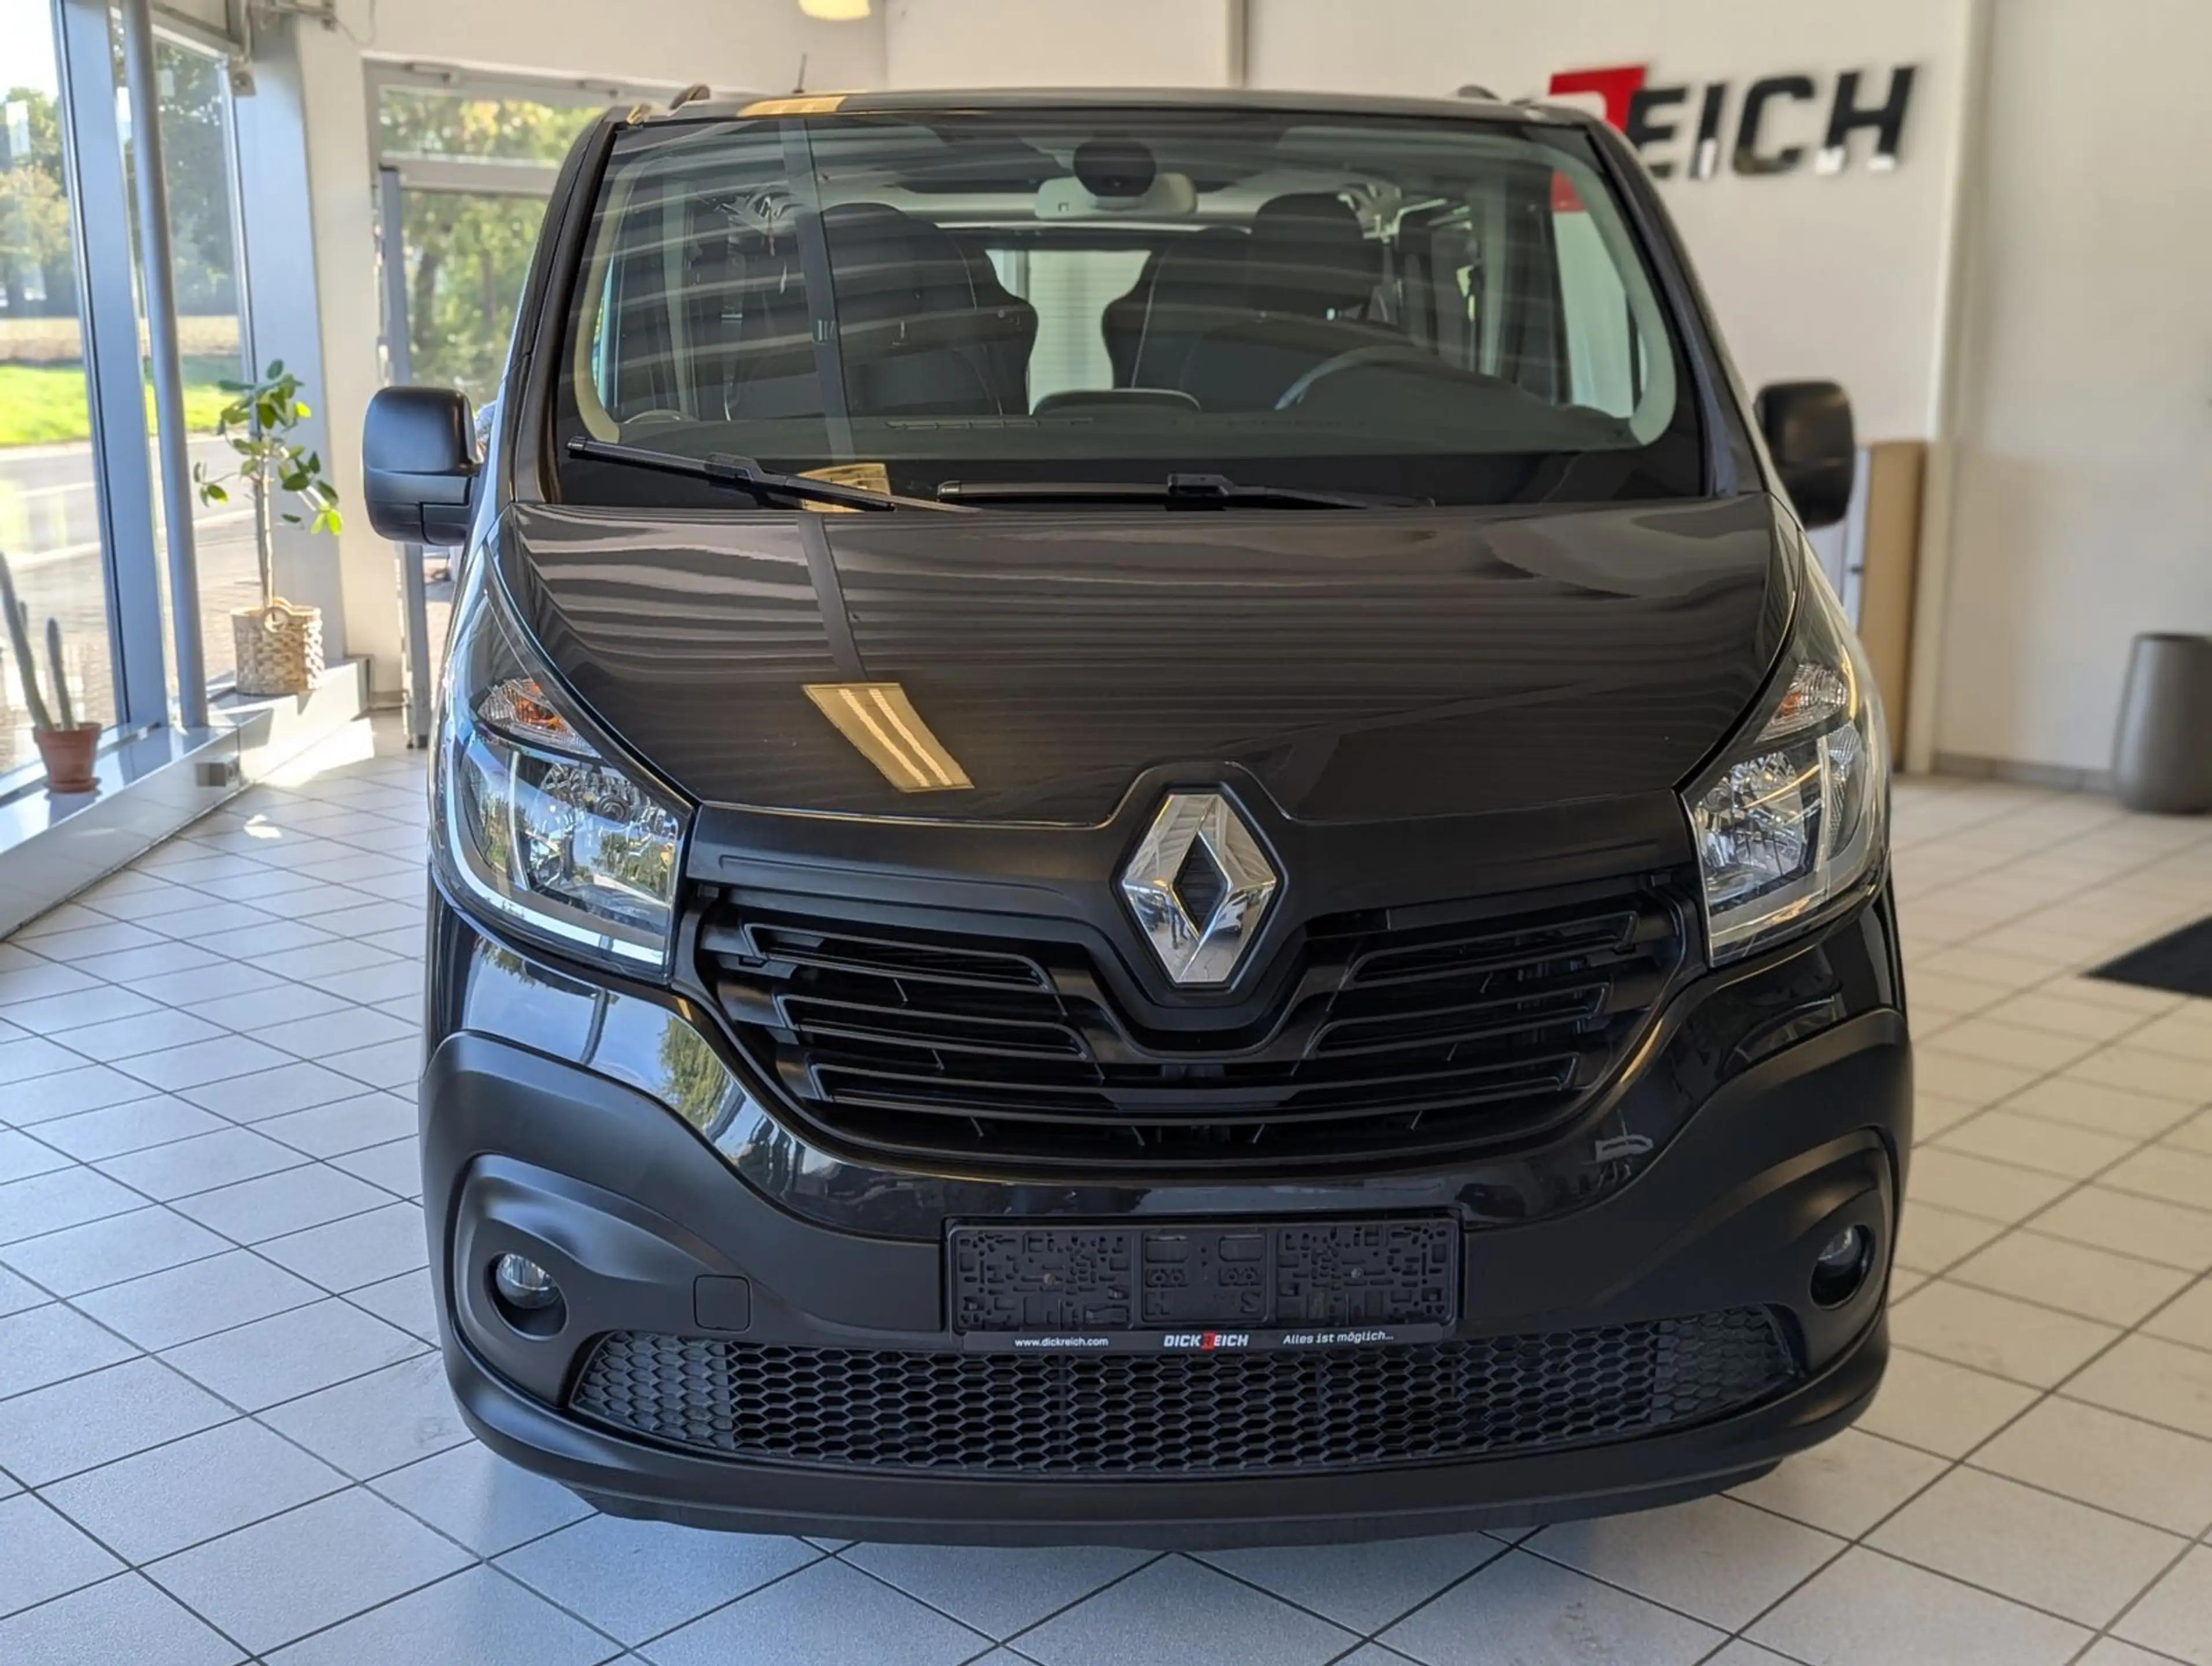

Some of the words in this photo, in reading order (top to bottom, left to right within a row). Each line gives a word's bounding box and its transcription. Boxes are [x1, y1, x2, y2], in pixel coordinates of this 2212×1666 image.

[1014, 1336, 1109, 1348] www.dickreich.com
[1282, 1334, 1314, 1345] Alles
[1316, 1333, 1334, 1344] ist
